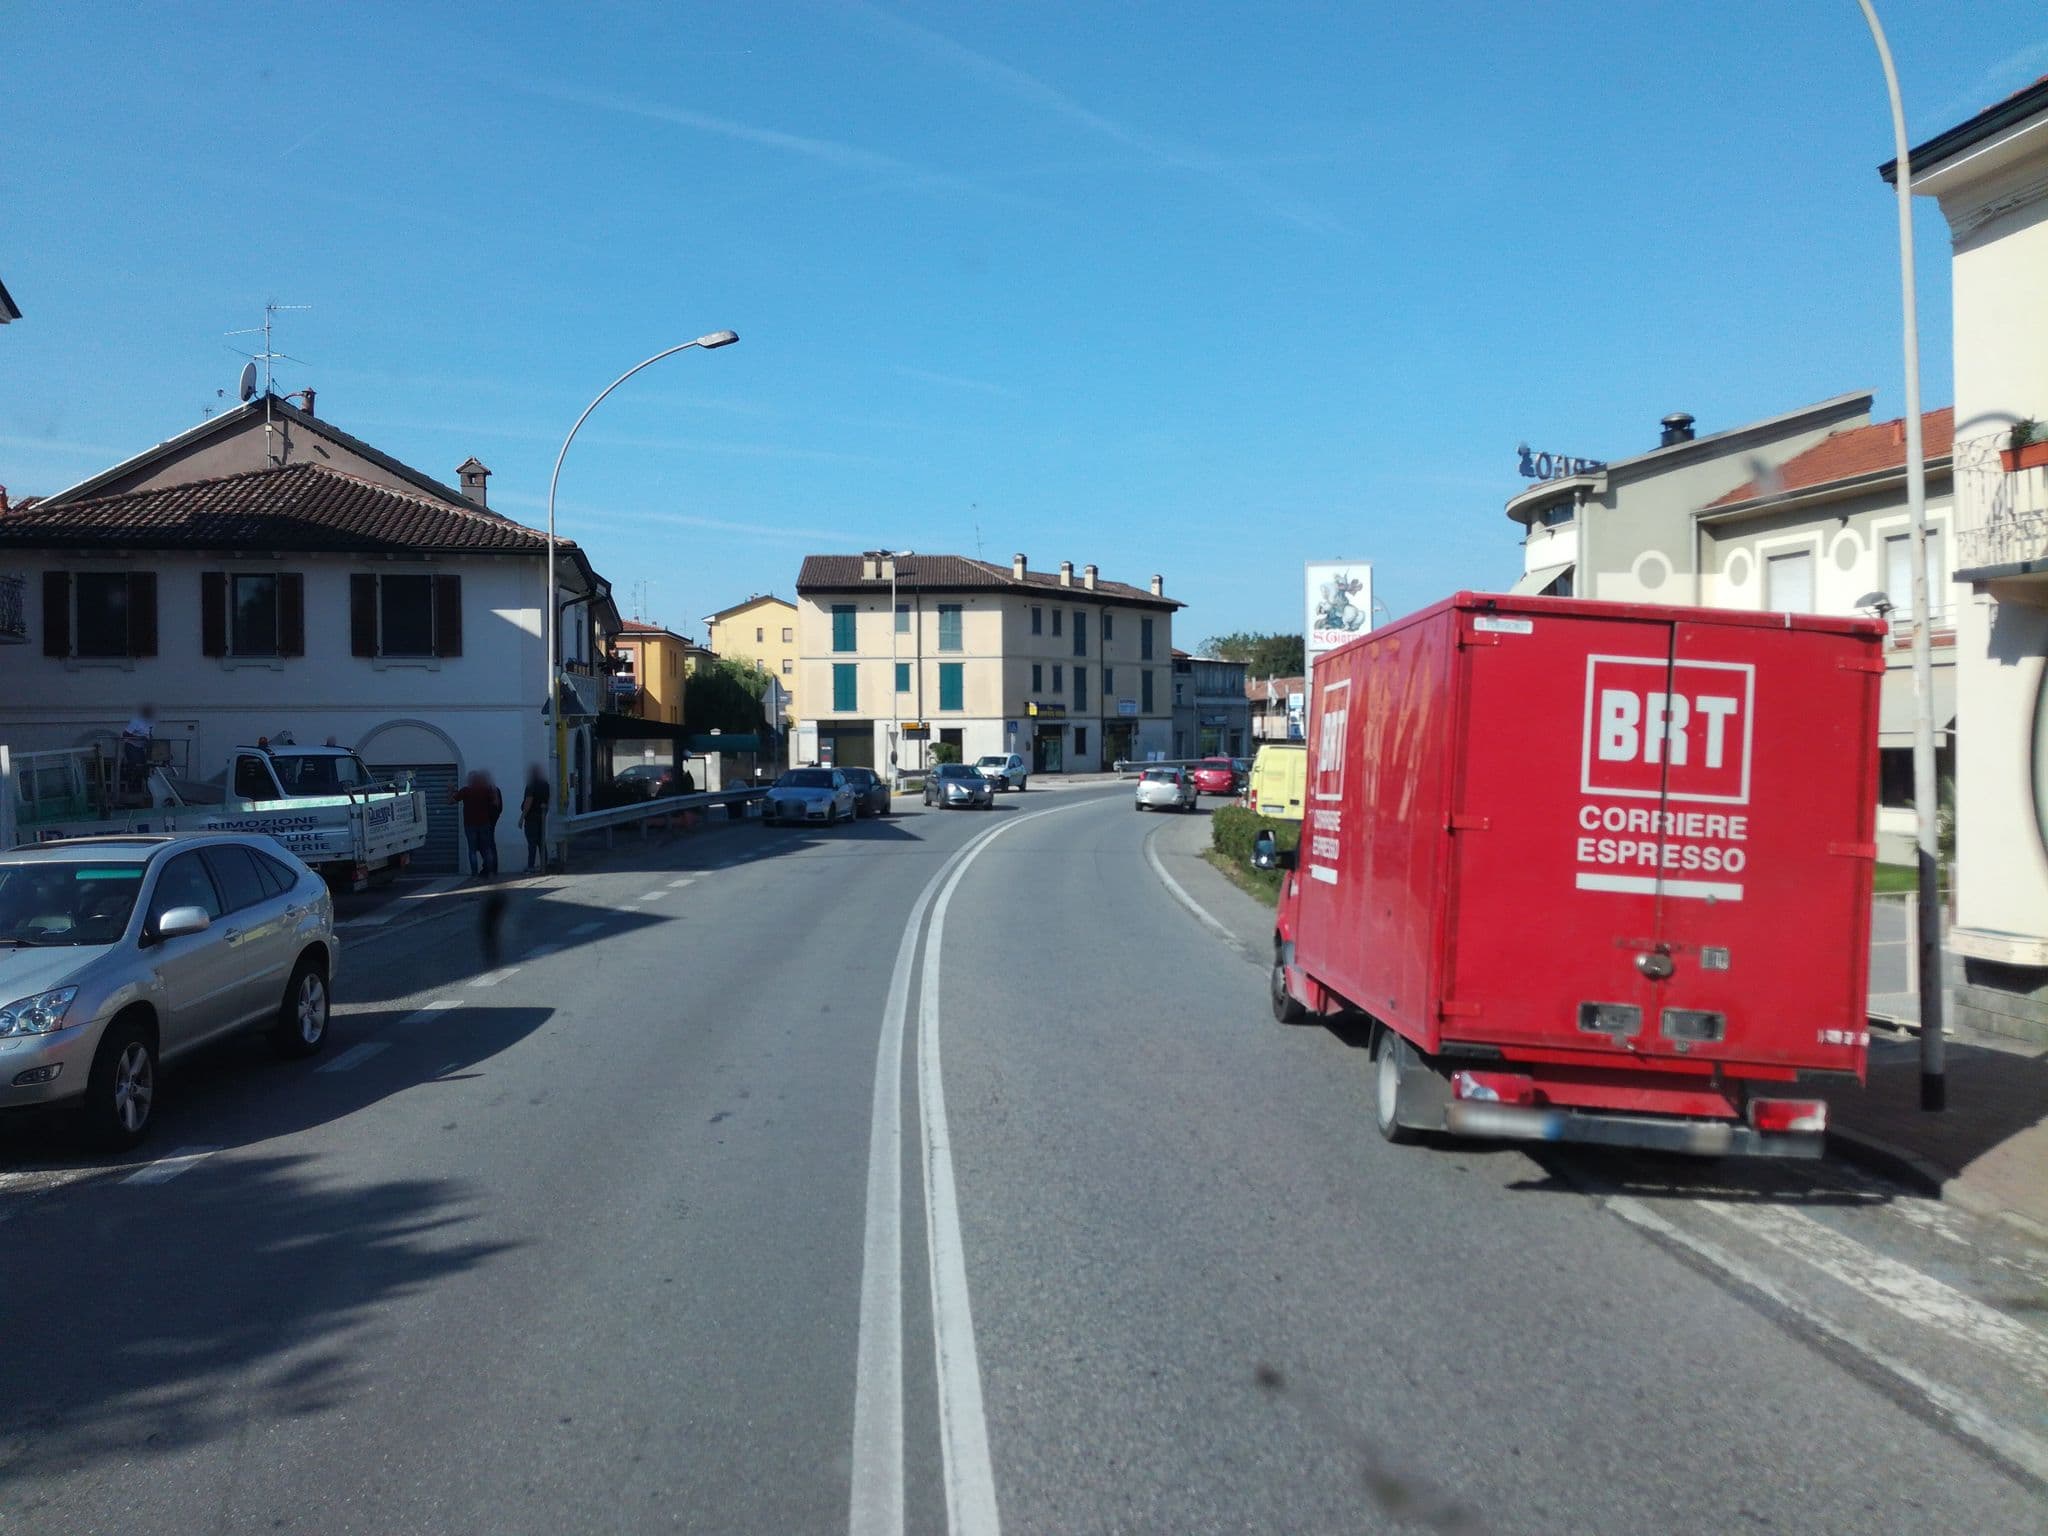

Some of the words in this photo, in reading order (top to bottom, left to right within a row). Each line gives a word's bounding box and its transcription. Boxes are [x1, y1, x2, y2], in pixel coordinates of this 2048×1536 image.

[1598, 689, 1738, 768] BRT
[207, 815, 319, 831] RIMOZIONE
[1579, 805, 1748, 840] CORRIERE
[1576, 837, 1745, 872] ESPRESSO
